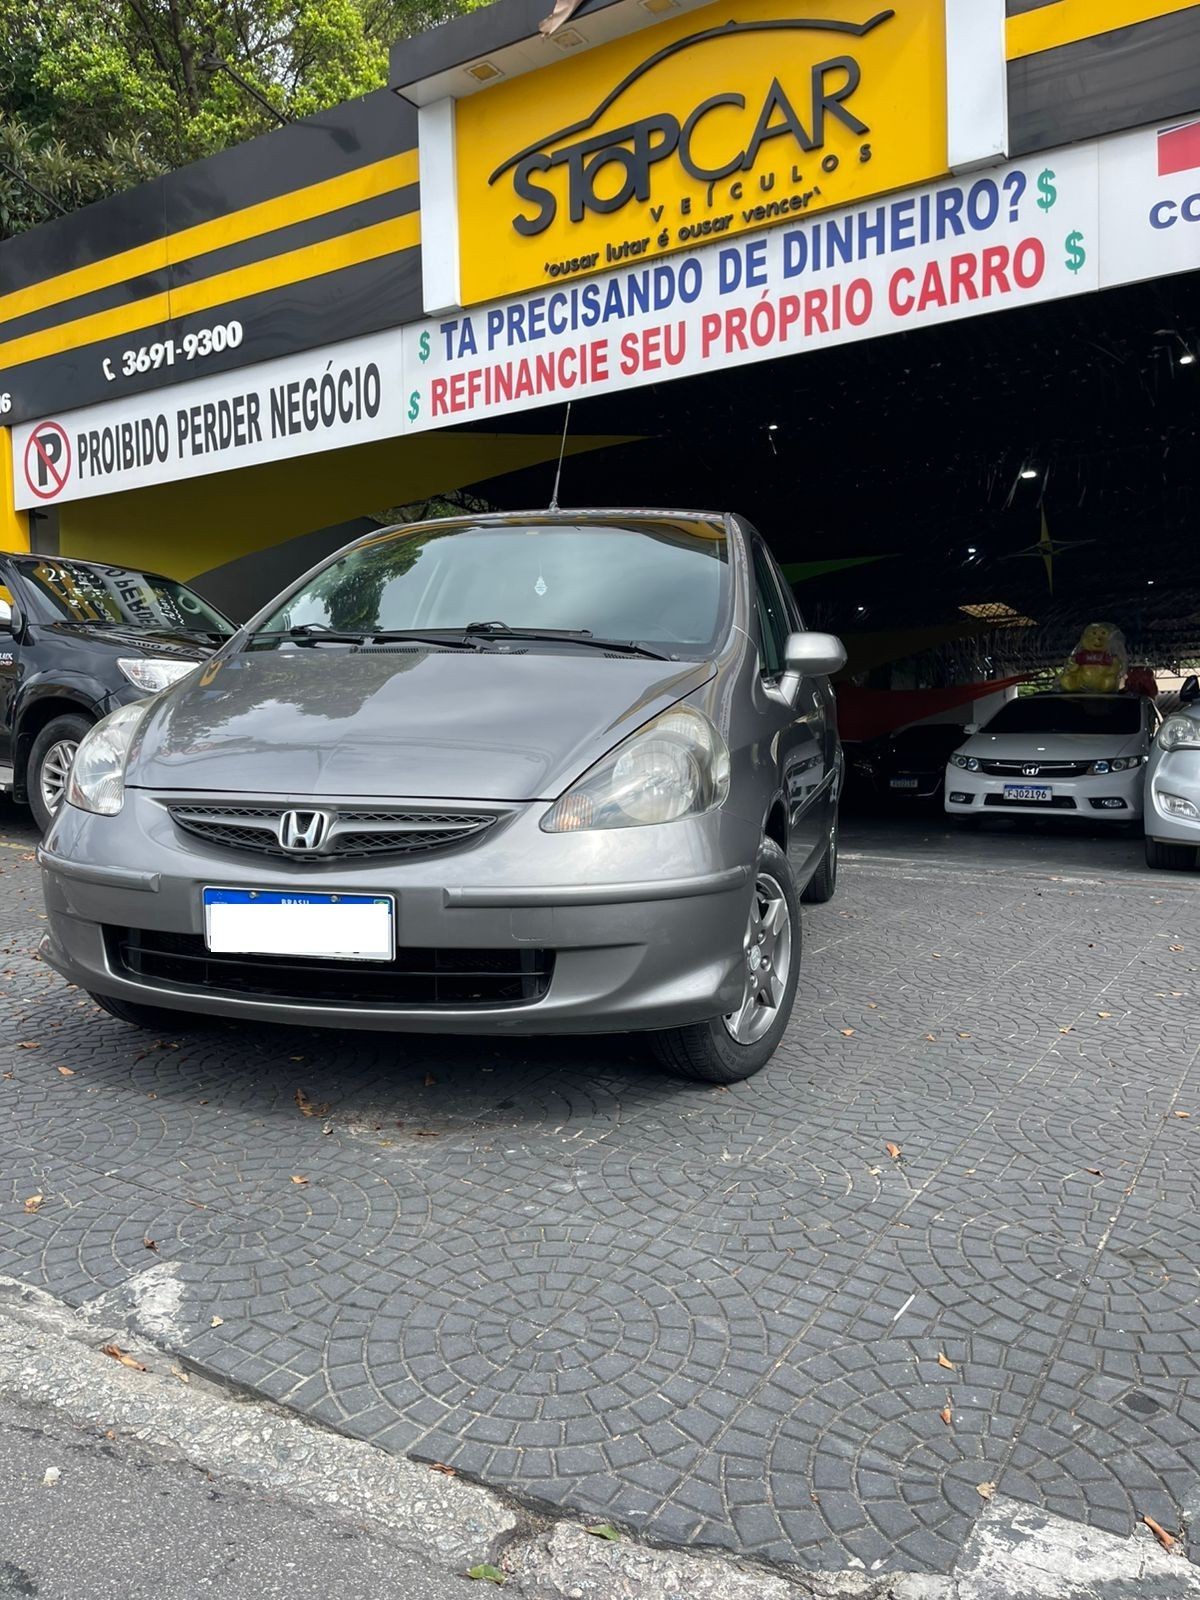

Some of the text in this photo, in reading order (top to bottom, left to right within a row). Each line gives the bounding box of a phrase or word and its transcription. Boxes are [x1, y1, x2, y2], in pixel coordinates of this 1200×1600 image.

[650, 143, 872, 223] VEÍCULOS
[440, 317, 477, 361] TA
[487, 258, 702, 350] PRECISANDO
[719, 239, 768, 294] DE
[783, 170, 1027, 279] DINHEIRO?
[606, 237, 650, 262] lutar
[657, 228, 669, 247] é
[678, 214, 733, 241] ousar
[122, 319, 243, 375] 3691-9300
[431, 339, 609, 416] REFINANCIE
[620, 322, 686, 376] SEU
[702, 288, 873, 358] PRÓPRIO
[888, 237, 1045, 316] CARRO
[77, 414, 169, 479] PROIBIDO
[176, 392, 262, 459] PERDER
[270, 360, 382, 439] NEGÓCIO
